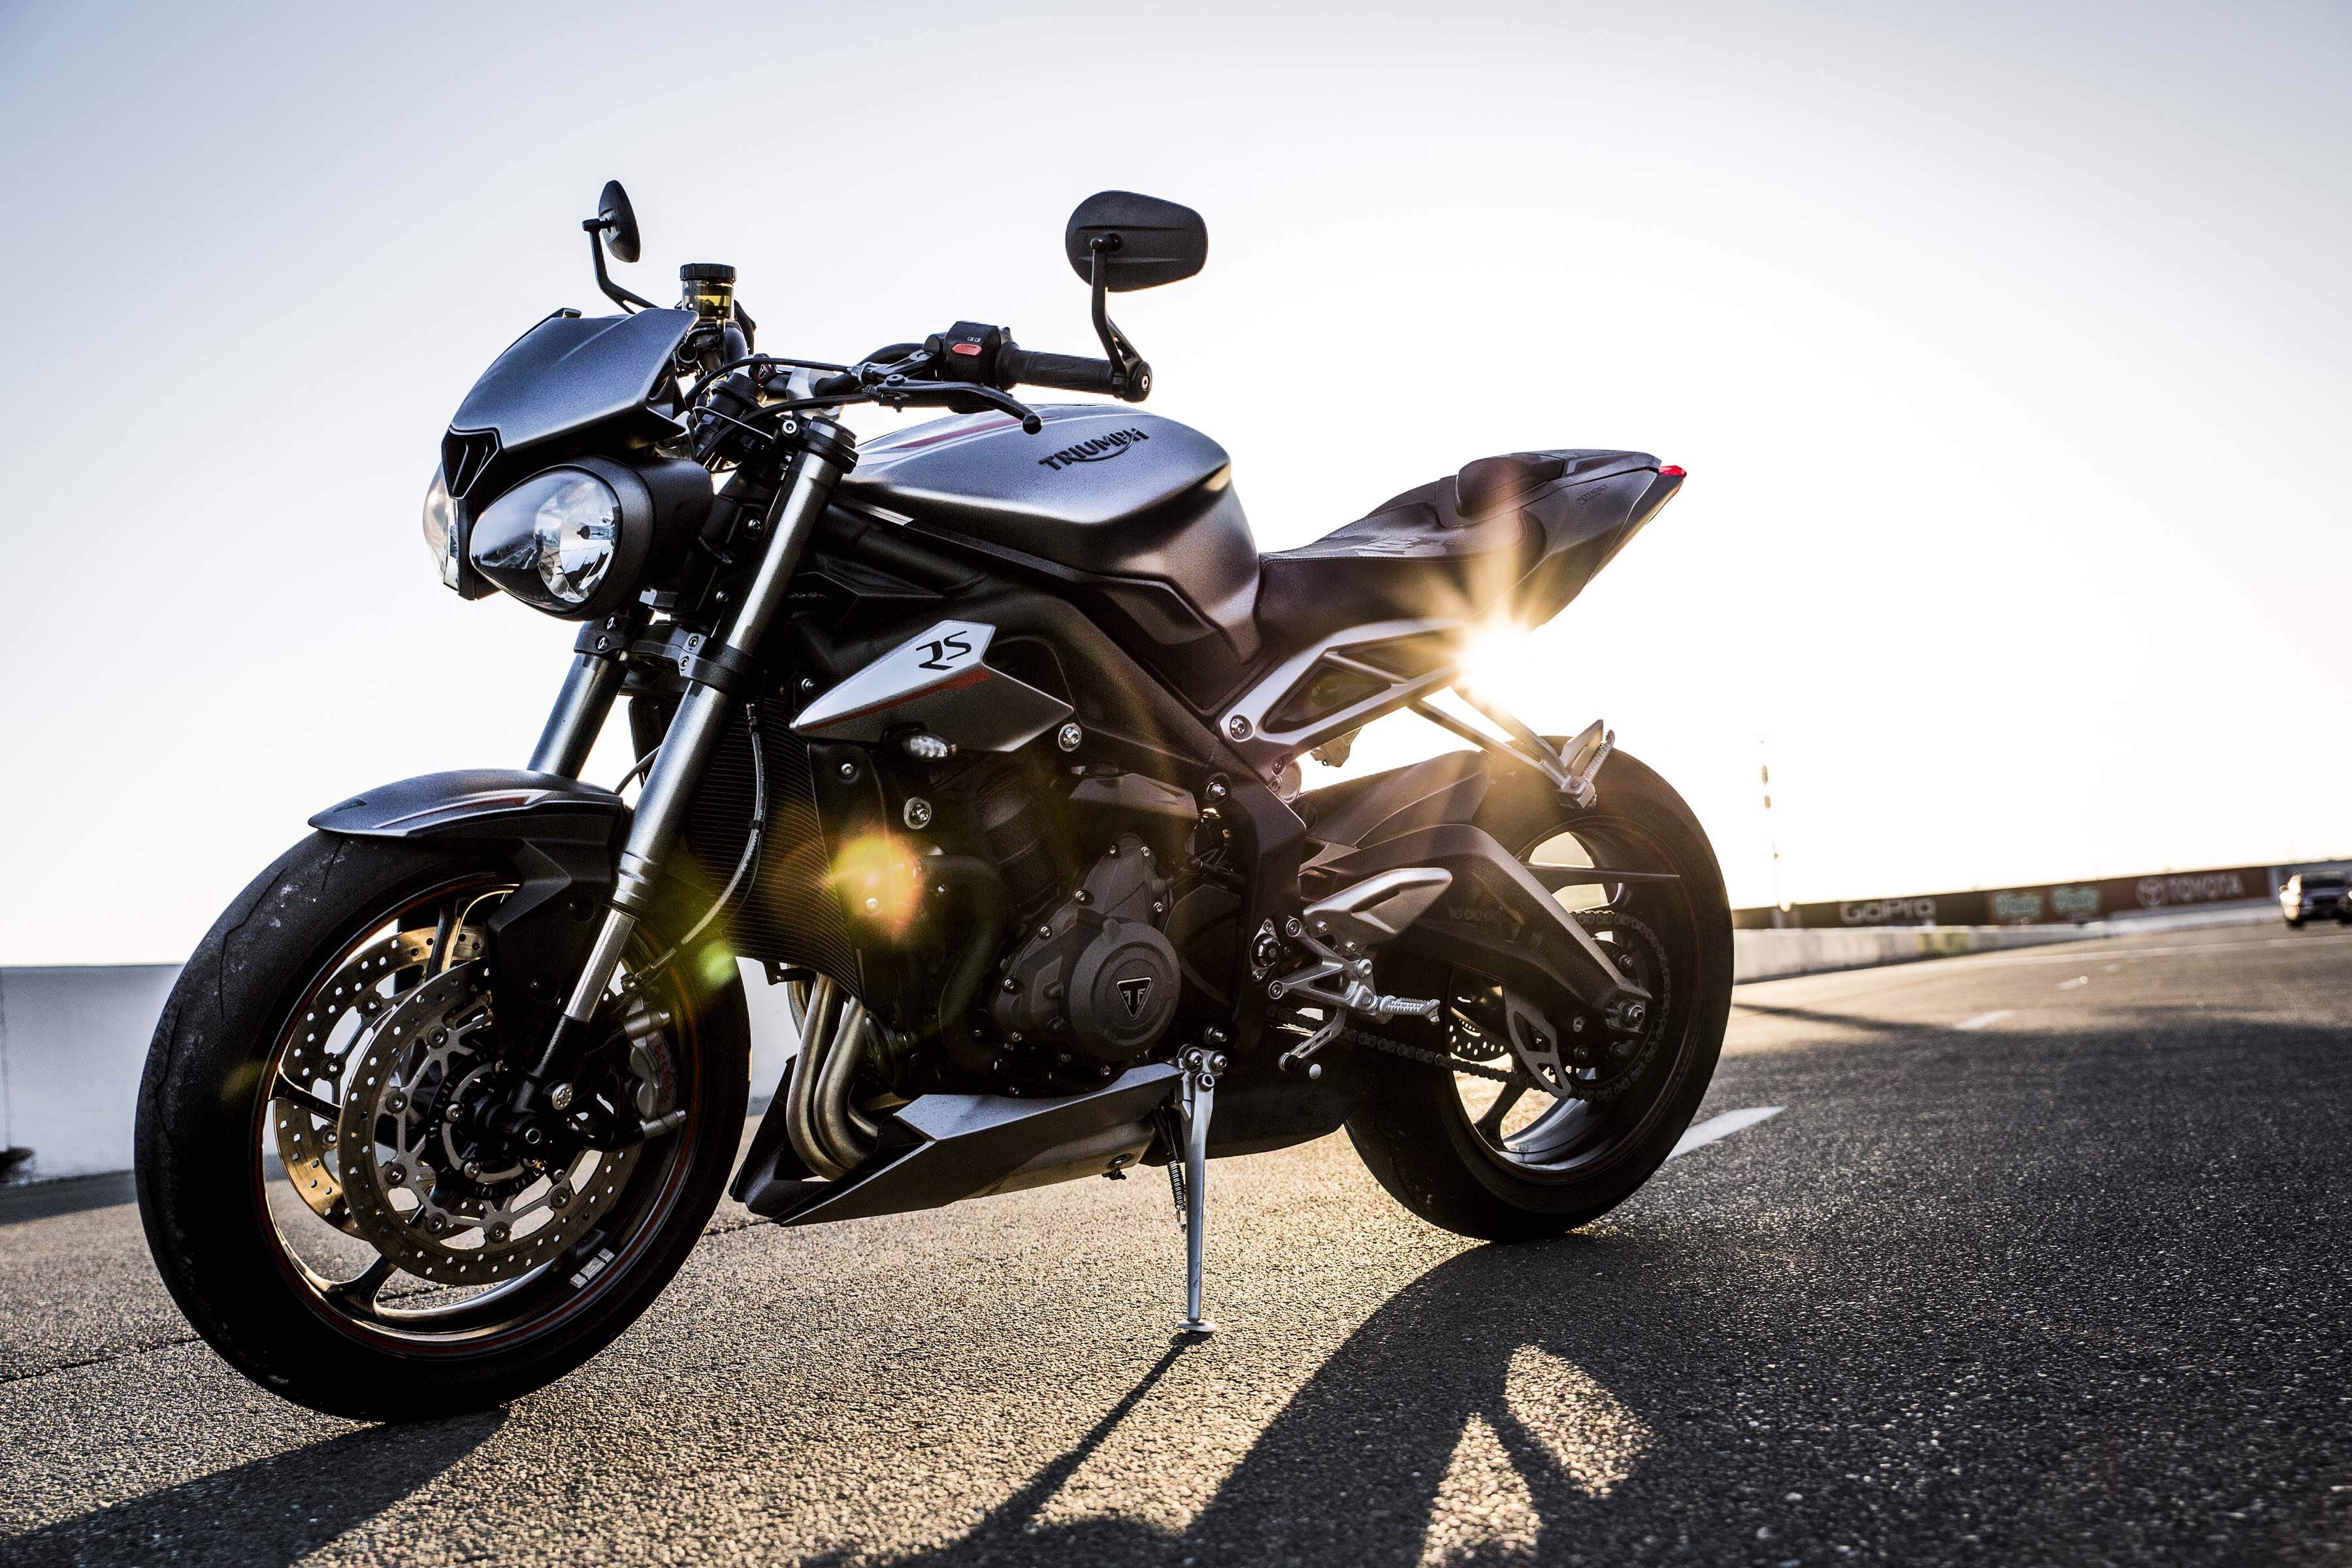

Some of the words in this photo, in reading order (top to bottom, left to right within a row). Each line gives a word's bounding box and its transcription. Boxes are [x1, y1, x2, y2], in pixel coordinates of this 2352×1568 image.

[1039, 427, 1150, 470] TRIUMPH
[915, 630, 972, 671] RS
[2167, 872, 2244, 903] TOYOTA
